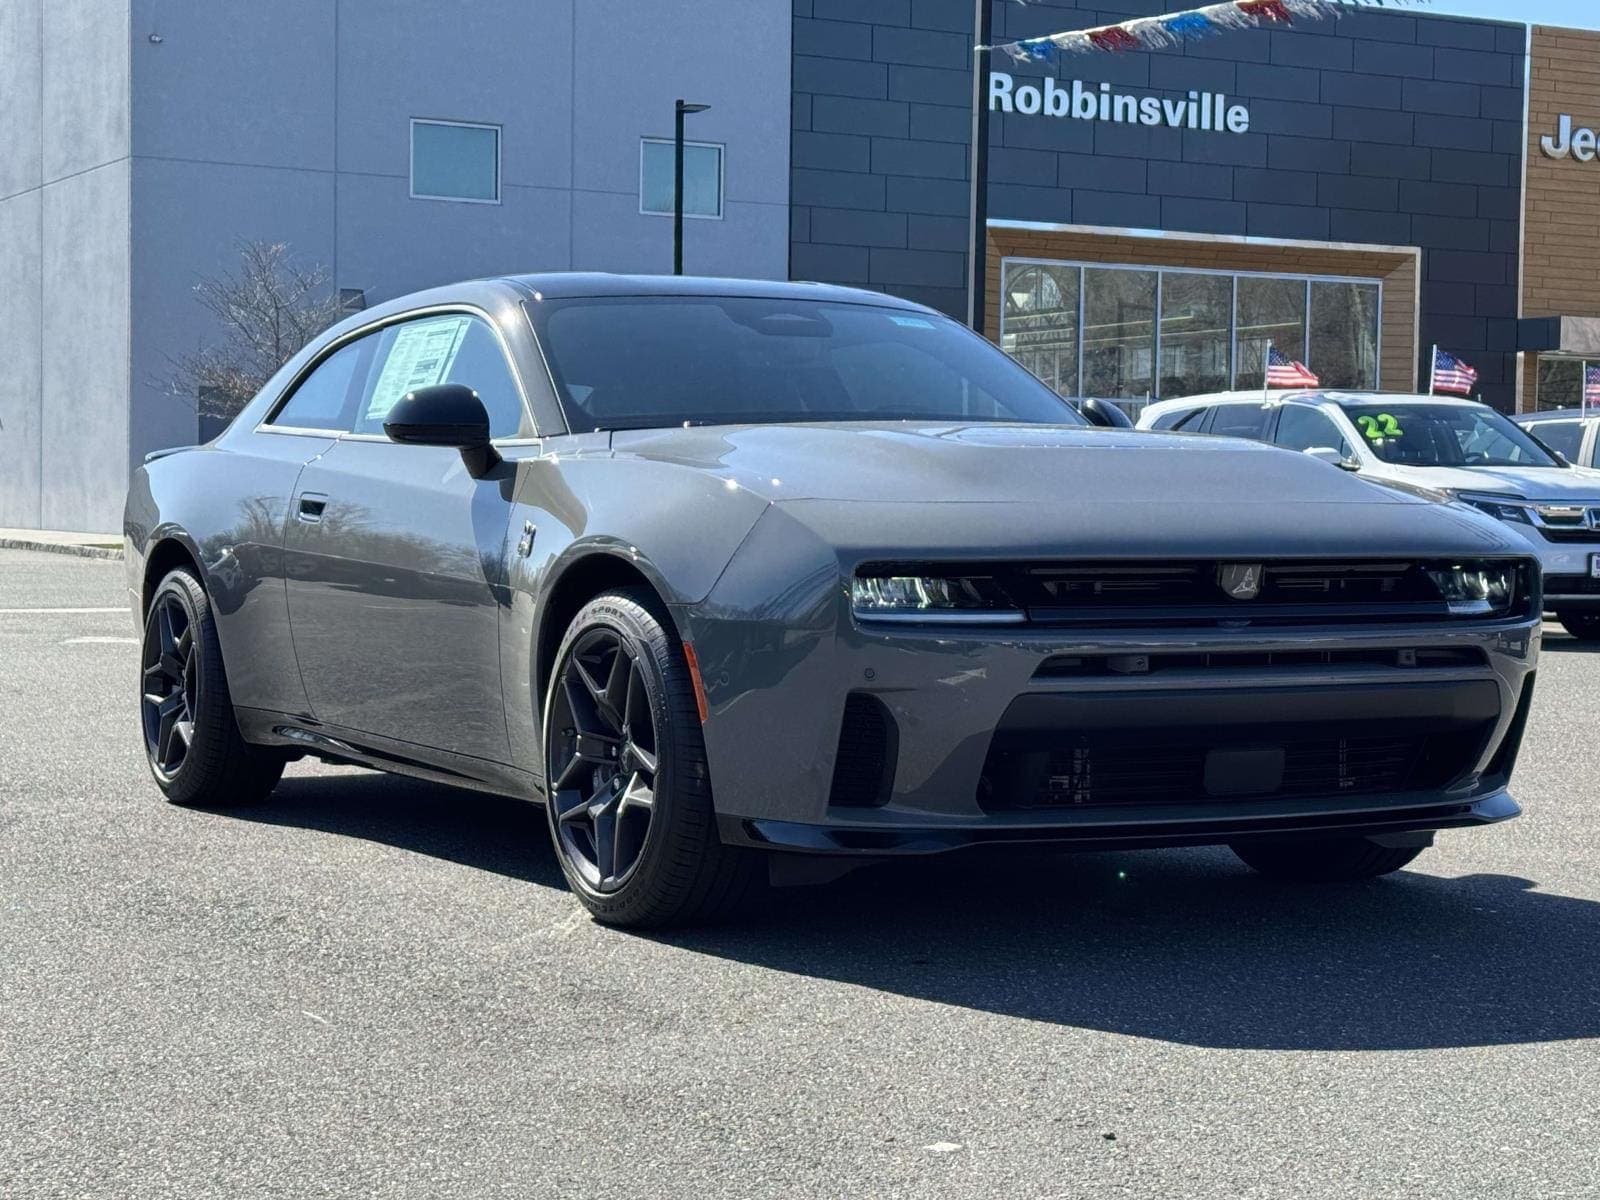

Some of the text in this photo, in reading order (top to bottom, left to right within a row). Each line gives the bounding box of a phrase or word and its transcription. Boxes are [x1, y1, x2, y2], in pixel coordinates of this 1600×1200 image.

[989, 71, 1250, 134] Robbinsville
[1540, 113, 1600, 162] Je
[1357, 413, 1404, 438] 22
[591, 605, 625, 619] SPORT
